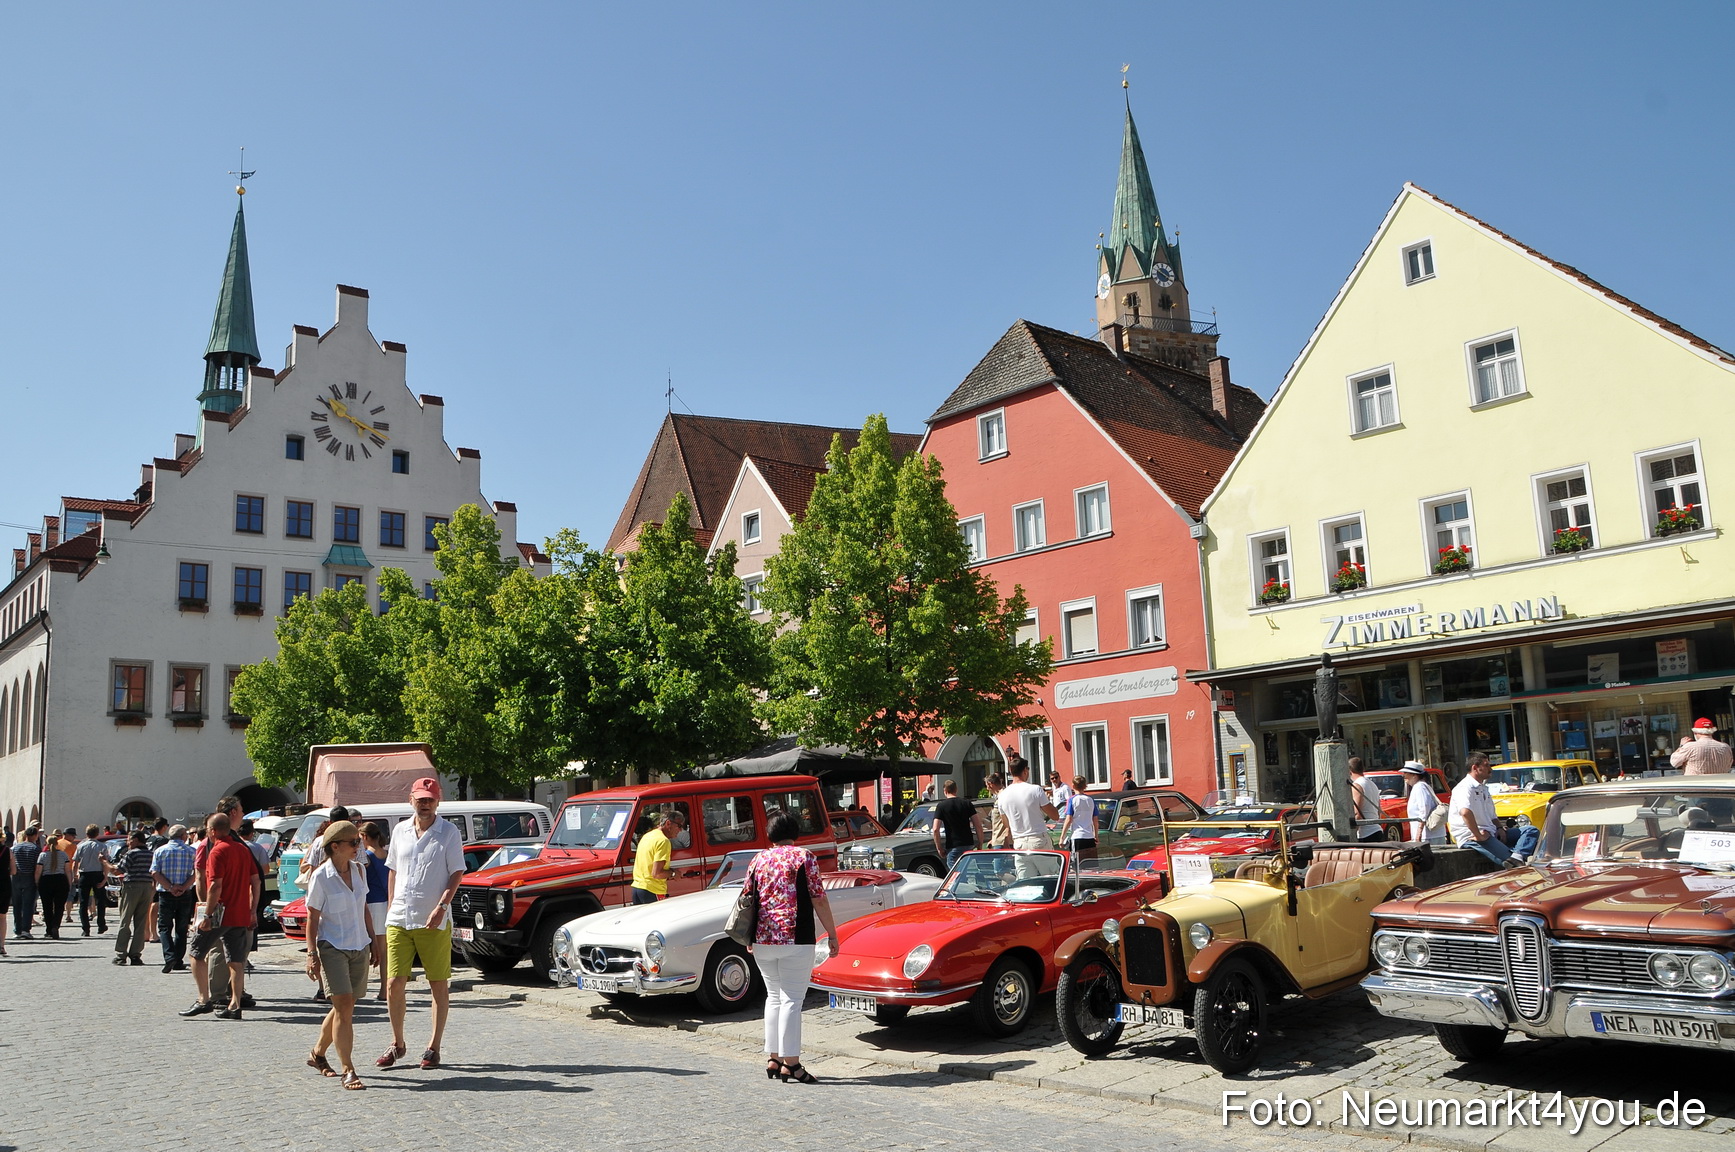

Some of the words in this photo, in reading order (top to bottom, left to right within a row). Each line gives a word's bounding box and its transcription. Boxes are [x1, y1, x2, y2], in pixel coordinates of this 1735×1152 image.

[1348, 606, 1415, 622] EISENWAREN
[1320, 595, 1559, 649] ZIMMERMANN
[1060, 686, 1106, 704] Gasthaus
[1108, 677, 1171, 695] Ehrnsberger
[1185, 710, 1195, 720] 19
[1710, 839, 1731, 848] 503
[1188, 860, 1202, 868] 113
[1122, 1006, 1137, 1021] RH
[1603, 1015, 1639, 1033] NEA
[1653, 1018, 1677, 1036] AN
[1680, 1021, 1718, 1041] 59H
